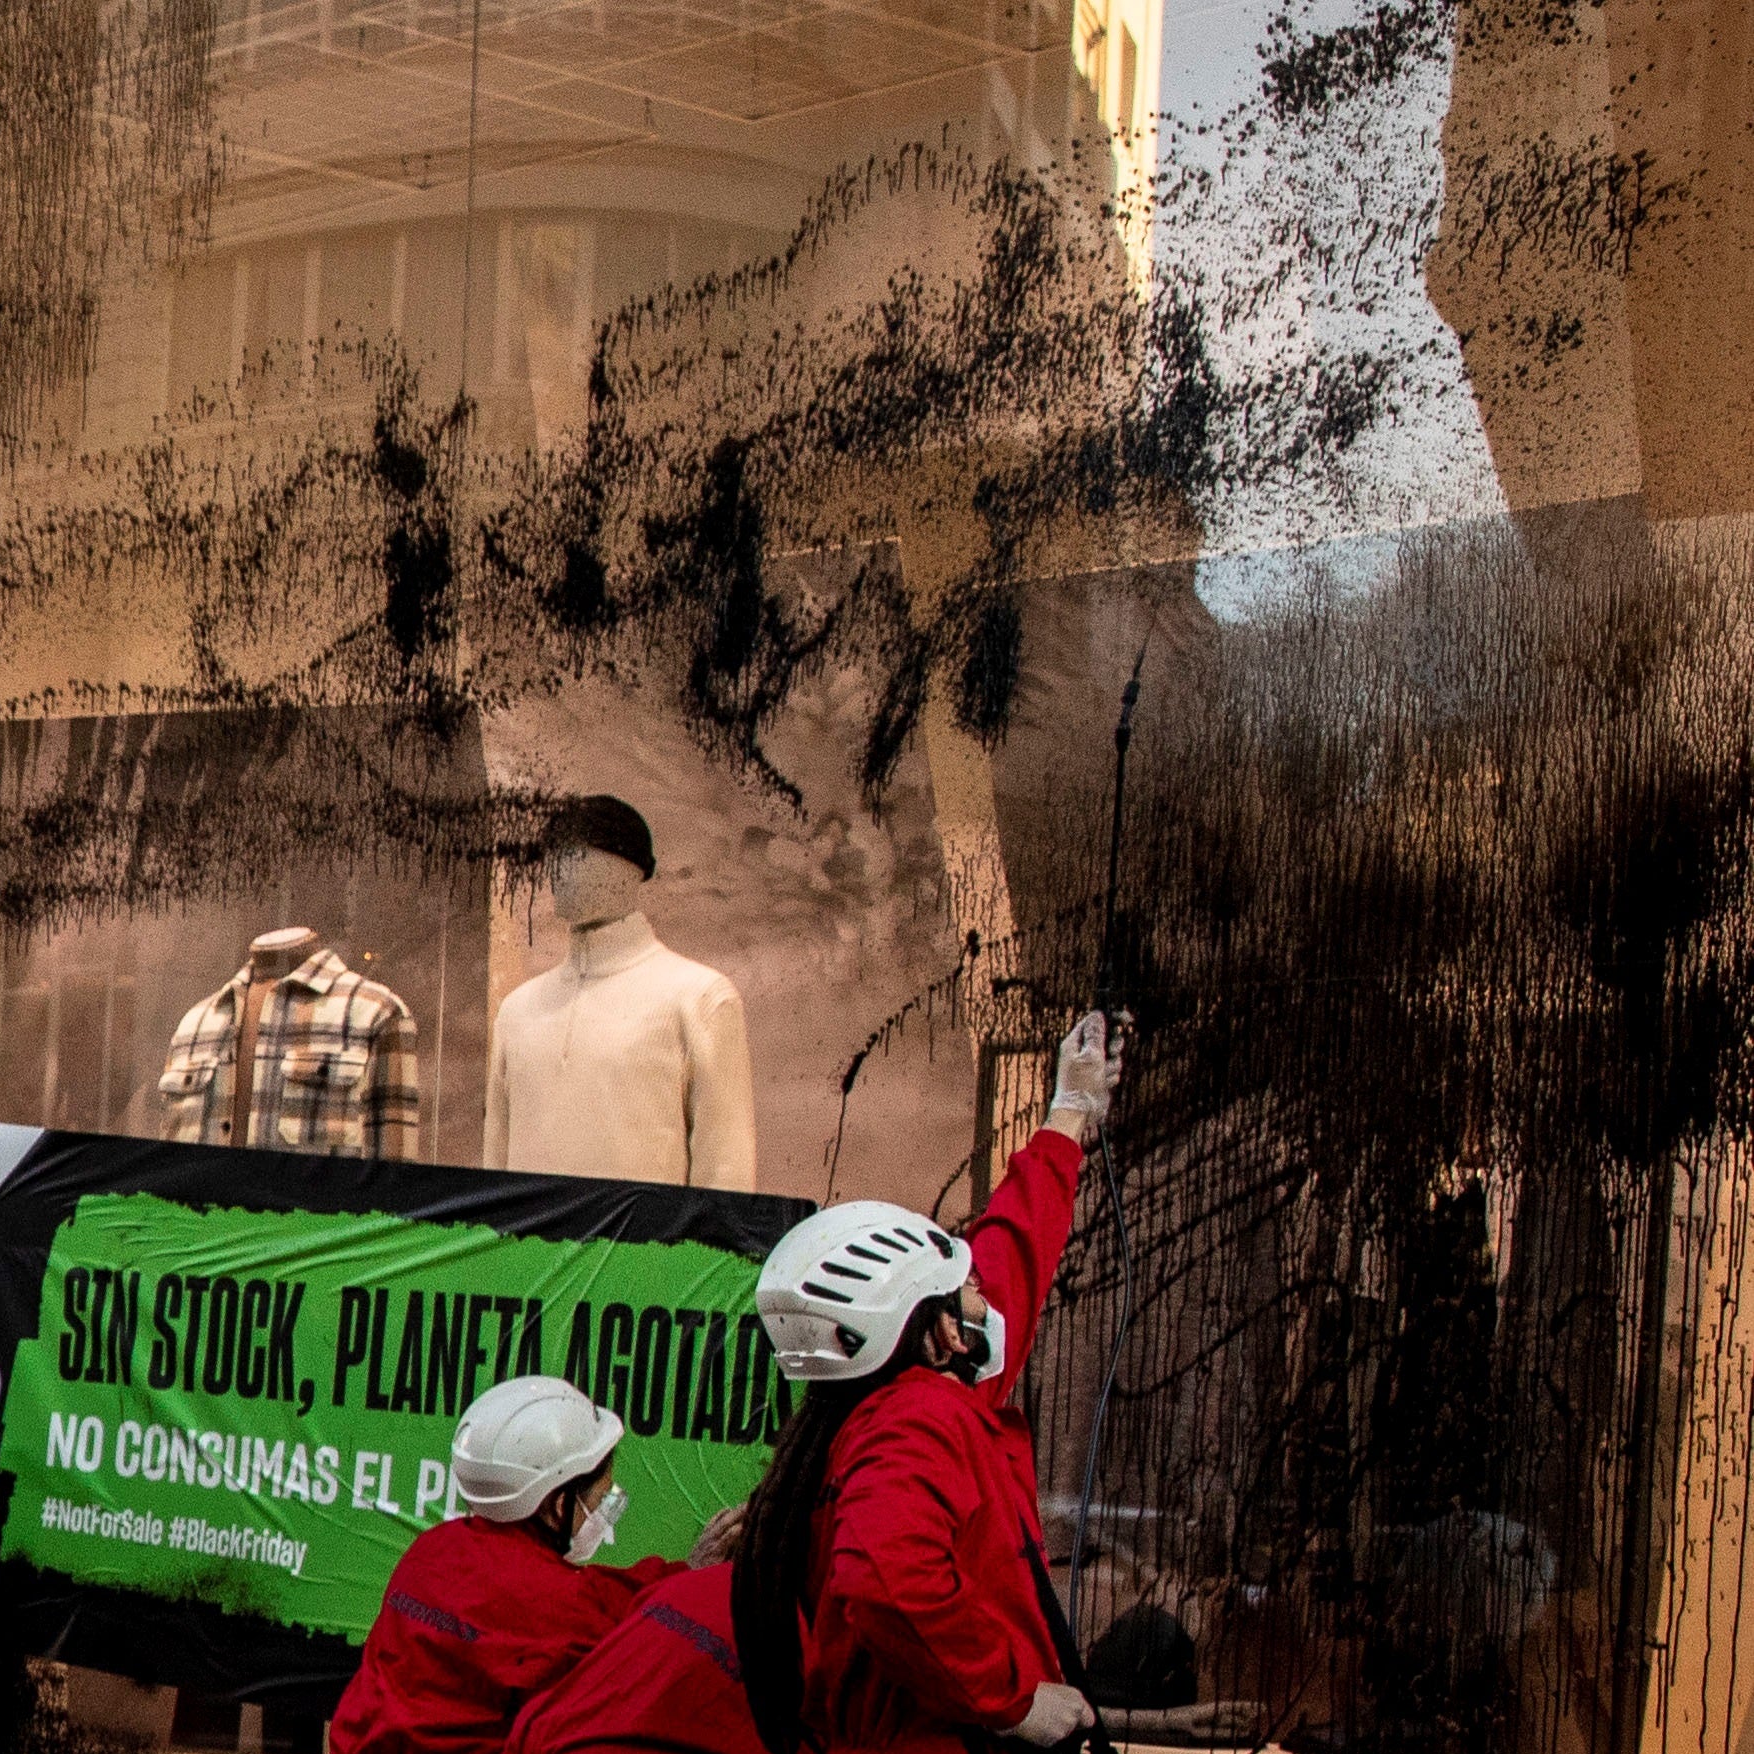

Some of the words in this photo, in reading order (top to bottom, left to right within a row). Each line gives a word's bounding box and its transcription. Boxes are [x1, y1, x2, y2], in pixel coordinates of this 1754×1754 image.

[58, 1266, 141, 1386] SIN
[147, 1272, 315, 1417] STOCK,
[45, 1411, 105, 1473] NO
[114, 1419, 341, 1505] CONSUMAS
[351, 1450, 400, 1515] EL
[41, 1496, 164, 1547] #NotForSale
[167, 1515, 308, 1577] #BlackFriday
